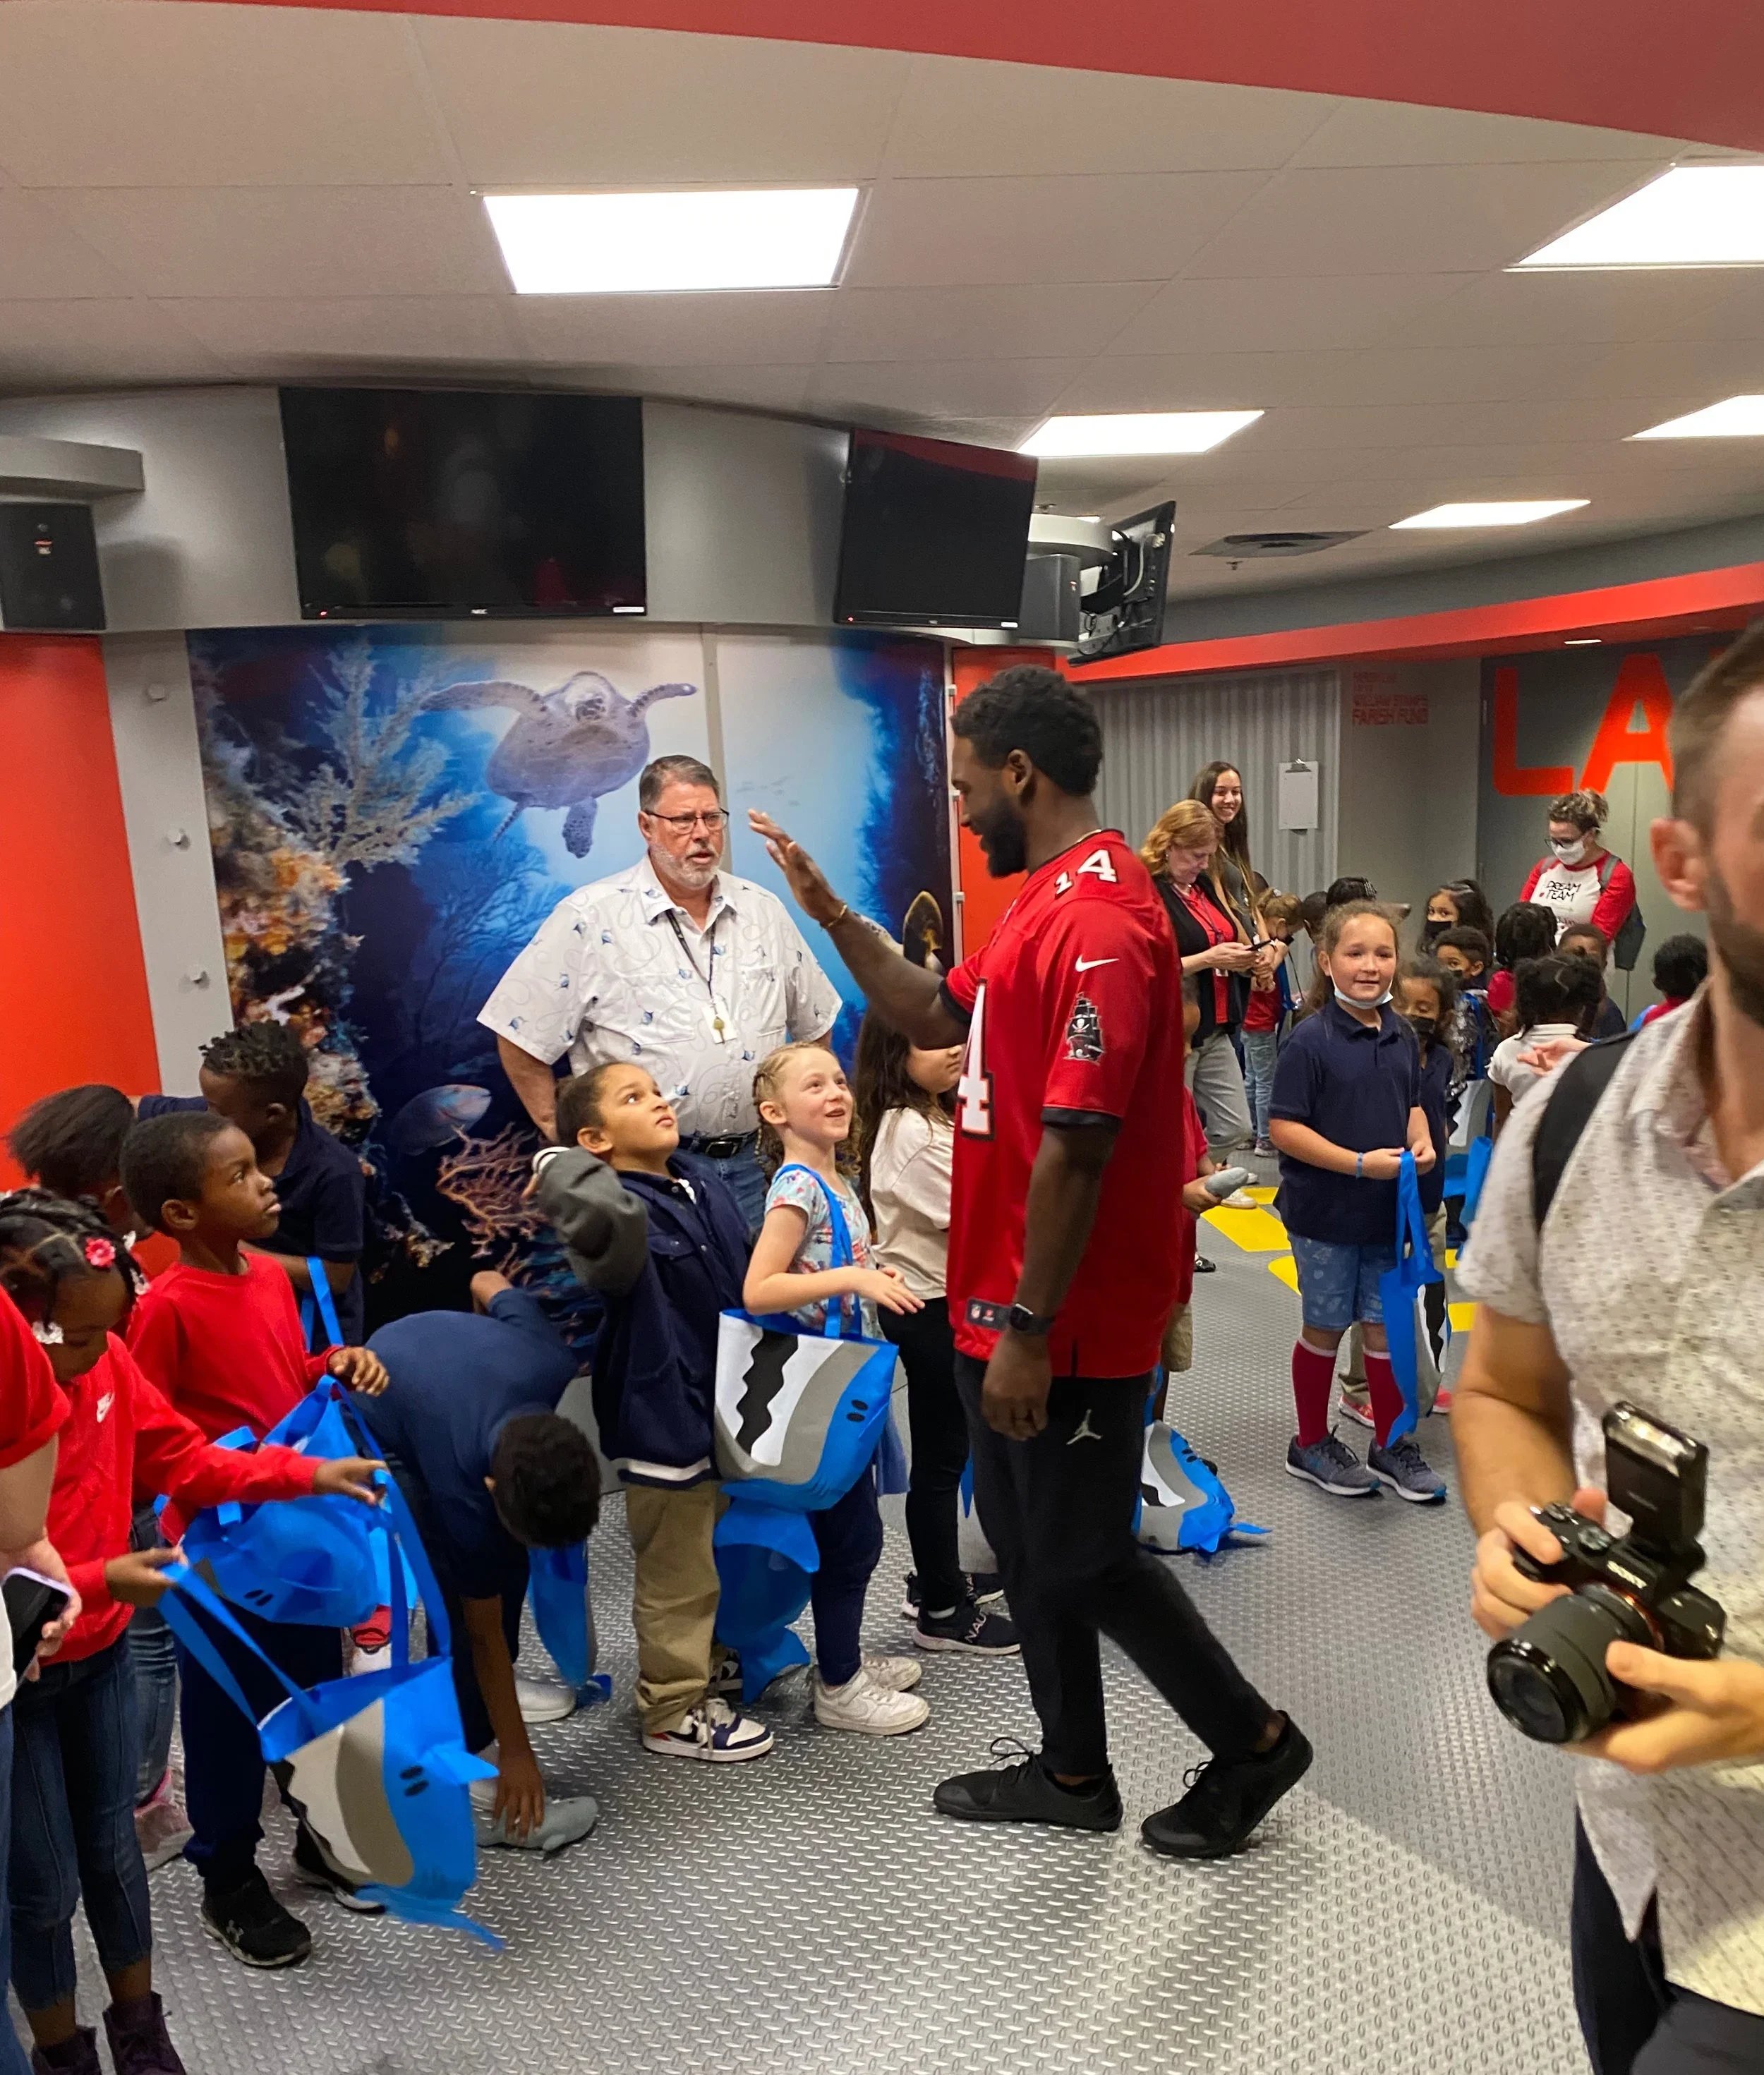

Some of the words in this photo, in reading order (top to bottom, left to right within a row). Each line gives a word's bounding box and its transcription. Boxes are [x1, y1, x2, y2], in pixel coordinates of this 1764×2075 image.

[1492, 647, 1727, 797] LA
[1546, 881, 1582, 893] DREAM
[1546, 889, 1575, 902] TEAM
